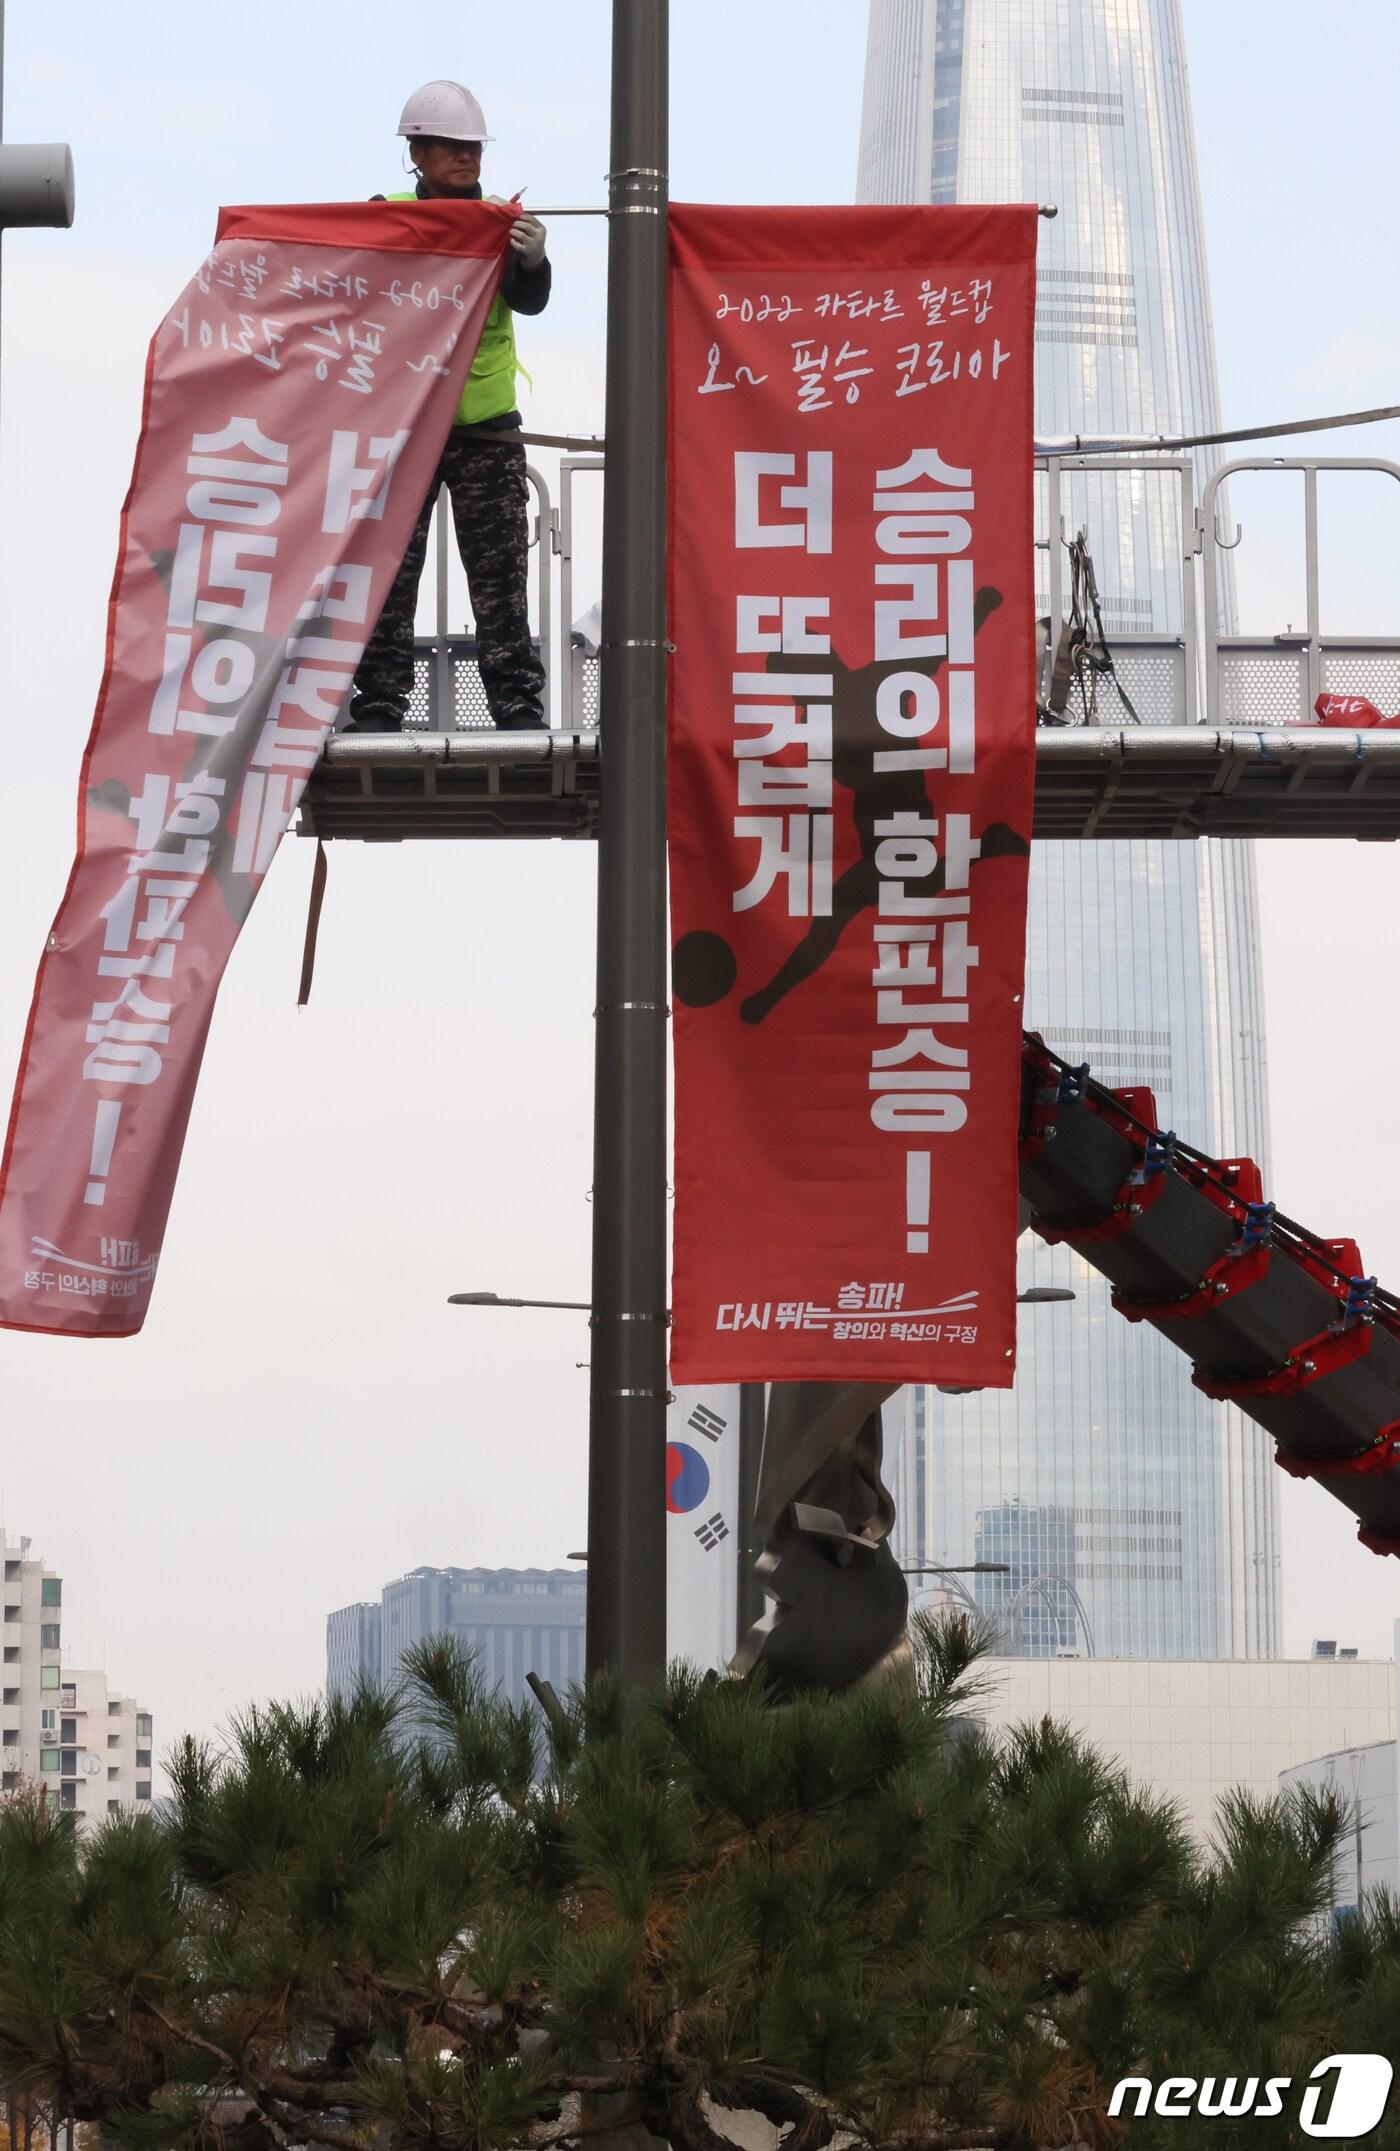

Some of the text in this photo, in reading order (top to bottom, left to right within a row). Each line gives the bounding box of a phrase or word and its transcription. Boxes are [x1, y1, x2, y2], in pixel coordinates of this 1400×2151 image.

[715, 279, 994, 326] 2022 카타르 월드컵
[791, 339, 874, 412] 필승
[895, 339, 1011, 397] 코리아
[873, 448, 976, 774] 승리의
[732, 450, 834, 917] 더 뜨겁게
[715, 1281, 905, 1331] 다시 뛰는 송파!
[832, 1321, 978, 1344] 창의와 혁신의 구정
